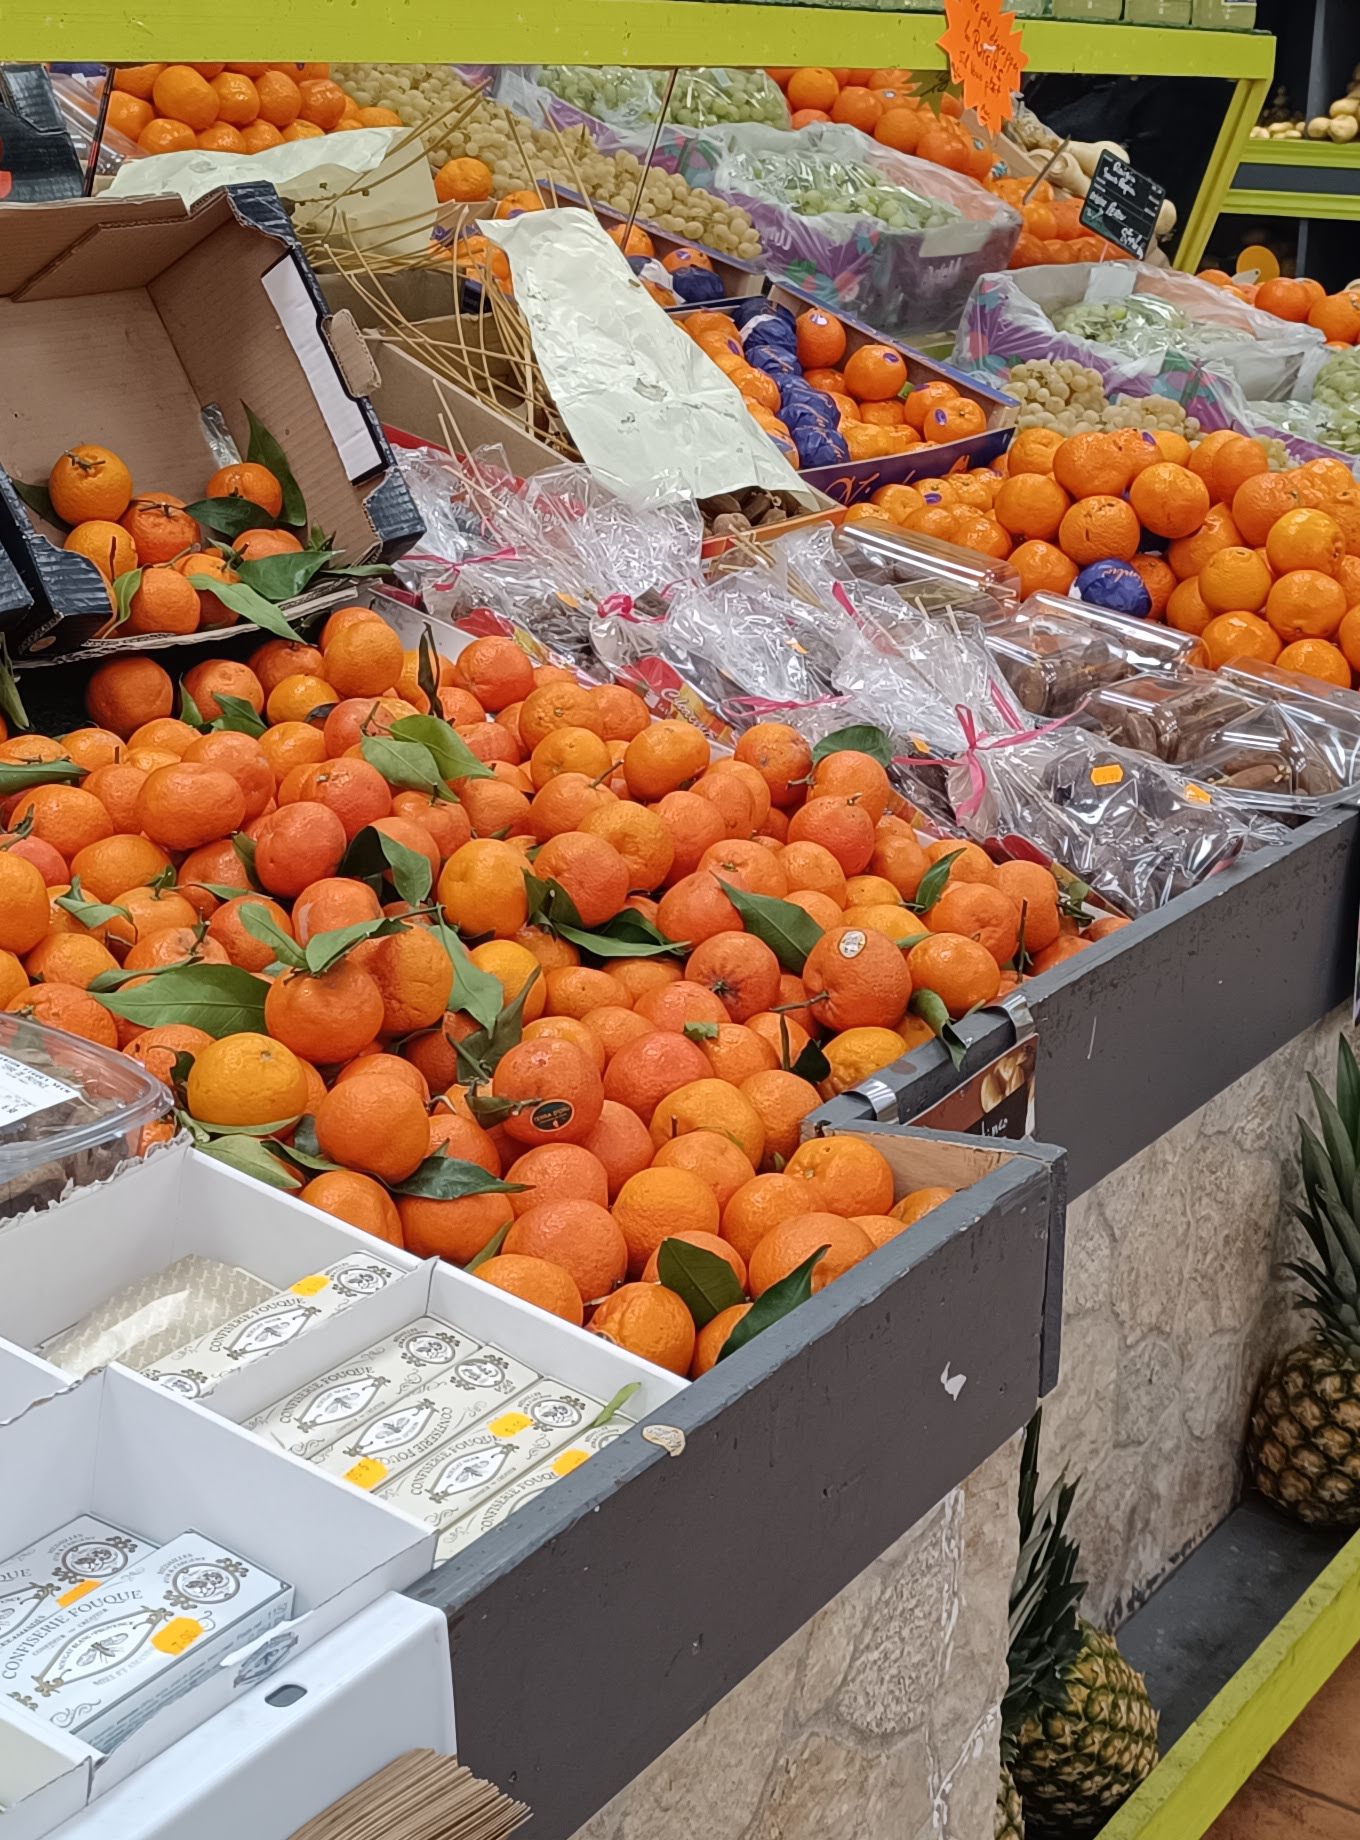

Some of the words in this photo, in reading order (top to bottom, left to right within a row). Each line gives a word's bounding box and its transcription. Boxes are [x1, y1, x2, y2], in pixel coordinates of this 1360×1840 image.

[209, 1310, 253, 1352] CONFISERIE
[252, 1297, 305, 1318] FOUQUE
[278, 1379, 322, 1424] CONFISERIE
[321, 1366, 376, 1388] FOUQUE
[410, 1444, 458, 1496] CONFISERIE
[1, 1614, 70, 1680] CONFISERIE
[71, 1589, 144, 1626] FOUQUE
